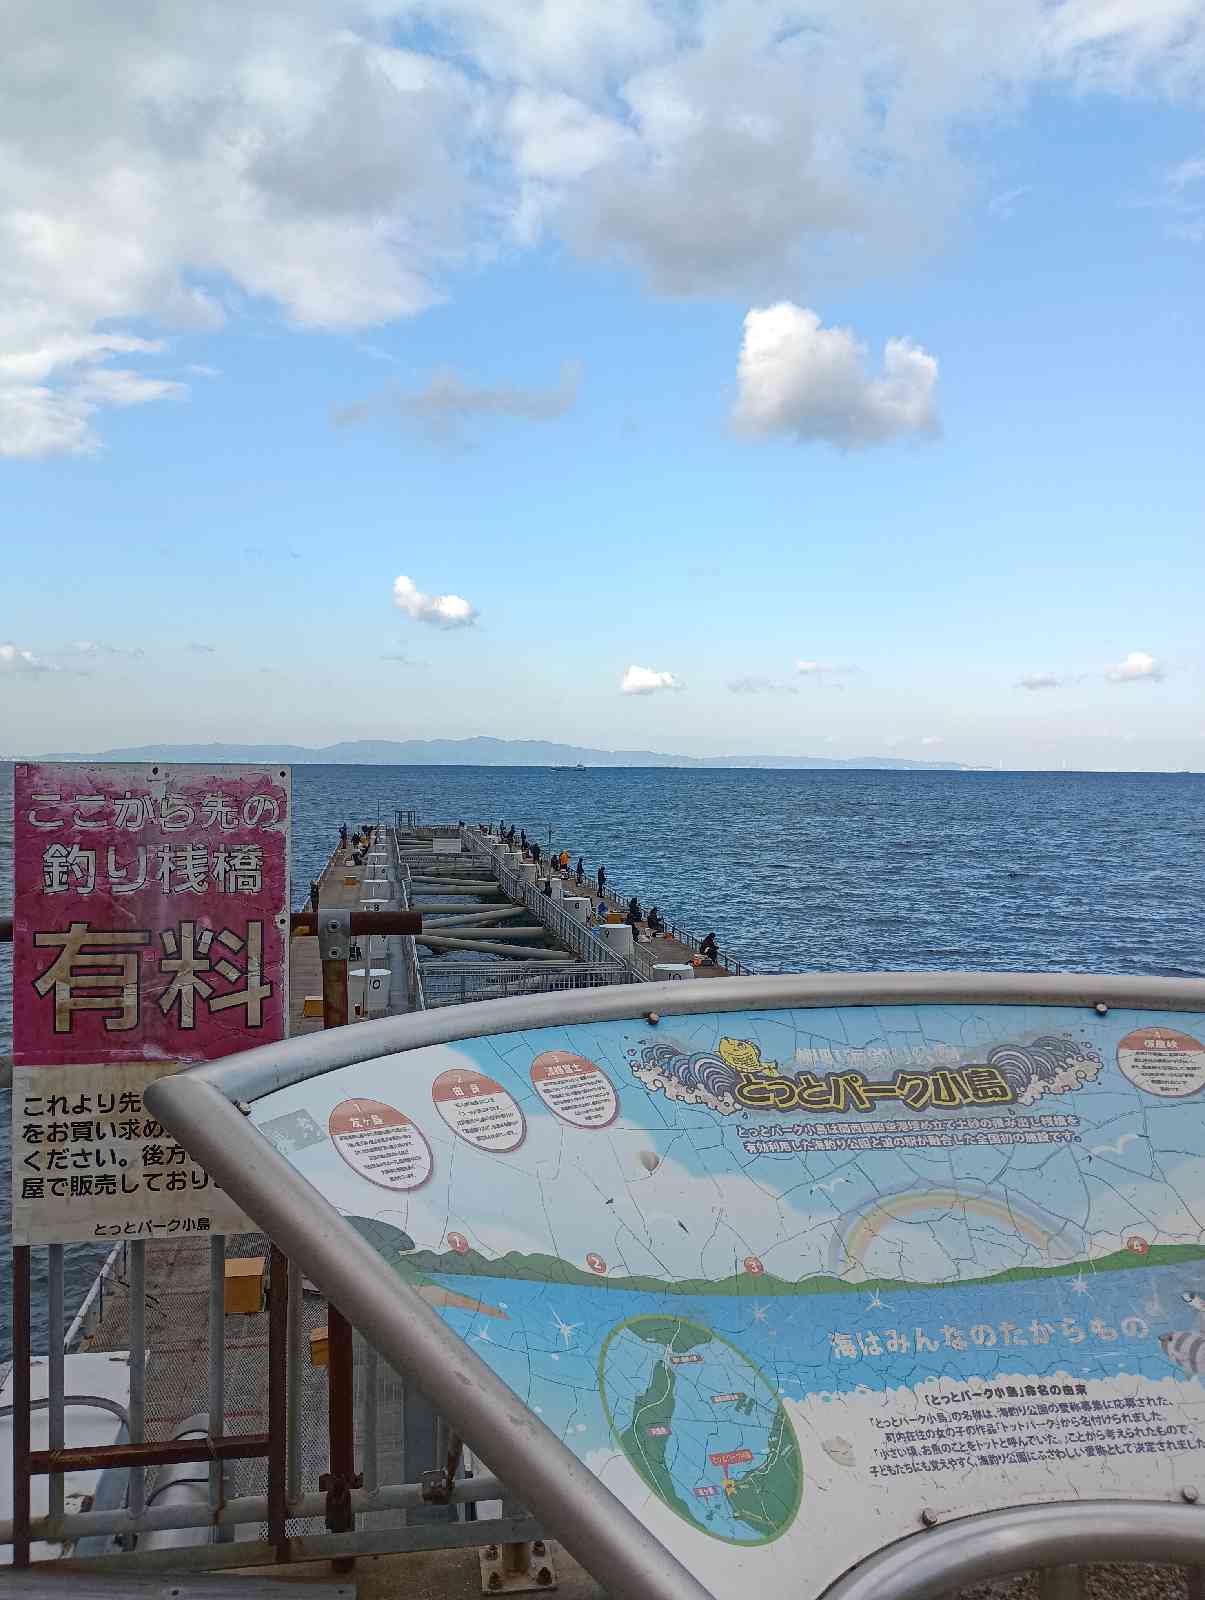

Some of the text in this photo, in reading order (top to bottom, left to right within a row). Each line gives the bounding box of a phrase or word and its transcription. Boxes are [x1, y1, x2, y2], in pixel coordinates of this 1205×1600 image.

[28, 792, 280, 831] ここから先の
[42, 843, 265, 895] 釣り桟橋
[33, 921, 272, 1033] 有料
[23, 1093, 143, 1117] これより先
[734, 1067, 1013, 1110] とっとパーク小島
[22, 1119, 174, 1143] をお買い求め
[23, 1145, 194, 1171] ください。後方
[21, 1169, 224, 1199] 屋で販売しており
[94, 1217, 211, 1236] とっとパーク小島
[828, 1315, 1150, 1359] 海はみんなのたからもの
